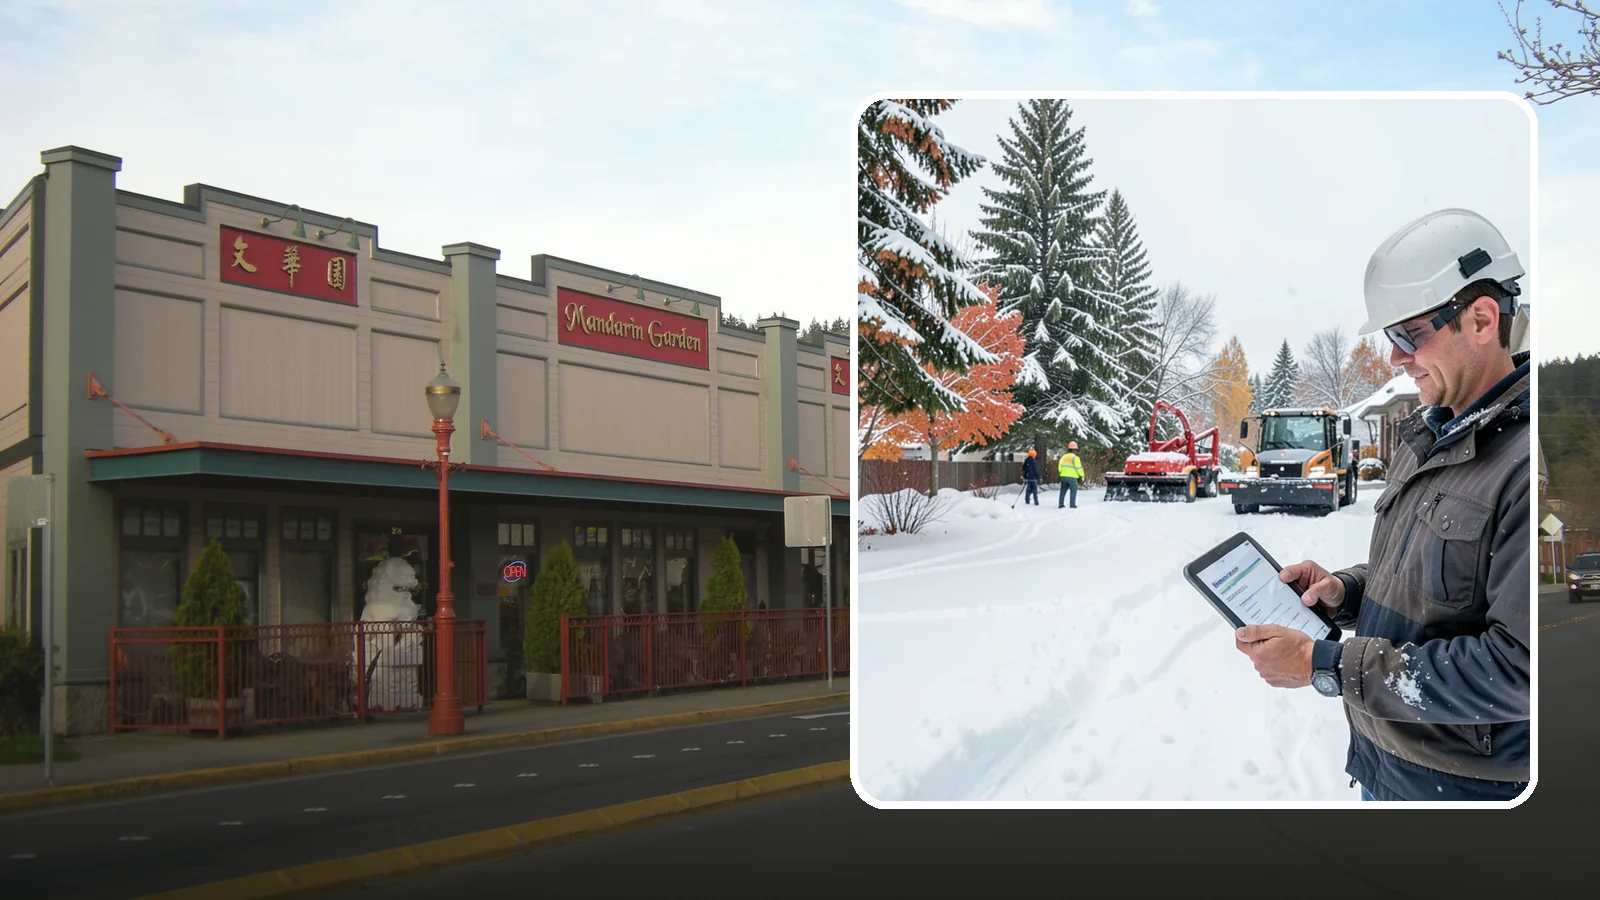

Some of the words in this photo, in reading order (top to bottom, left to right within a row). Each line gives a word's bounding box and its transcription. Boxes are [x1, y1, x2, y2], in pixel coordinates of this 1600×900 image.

[230, 235, 347, 291] 文華園
[564, 302, 644, 341] Mandarin
[647, 319, 702, 353] Garden
[391, 526, 402, 535] 28
[503, 565, 527, 578] OPEN
